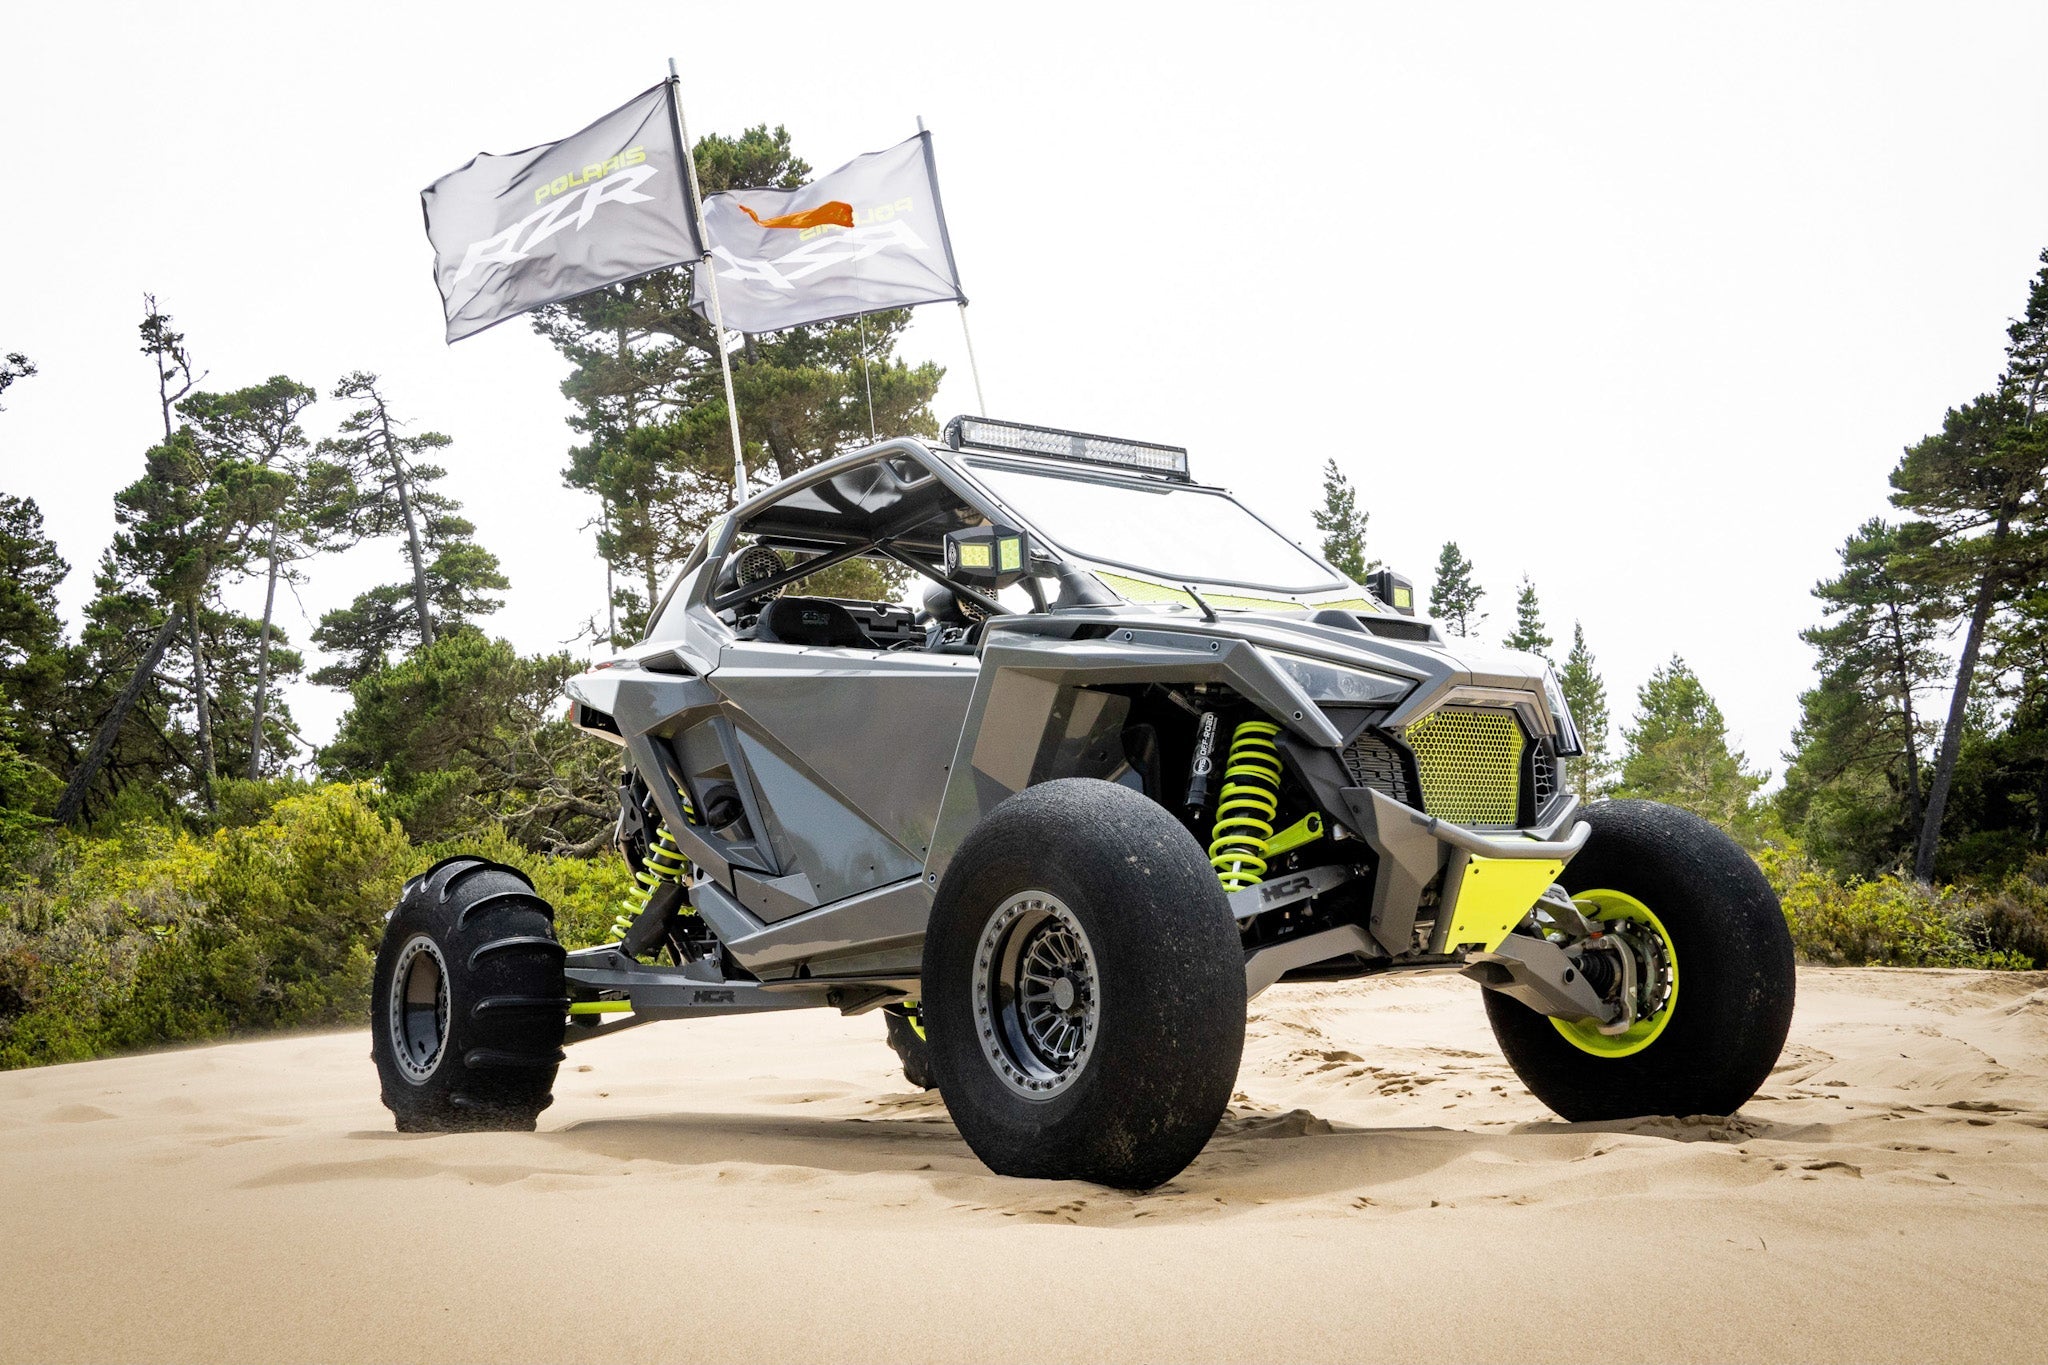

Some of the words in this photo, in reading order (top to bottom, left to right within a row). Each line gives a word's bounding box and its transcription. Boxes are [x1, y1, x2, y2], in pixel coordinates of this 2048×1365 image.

[534, 145, 647, 206] POLARIS
[453, 164, 659, 285] RZR
[1200, 714, 1214, 756] OFF-ROAD
[1405, 712, 1435, 738] RZR
[1262, 876, 1314, 903] HCR
[693, 990, 736, 1003] HCR
